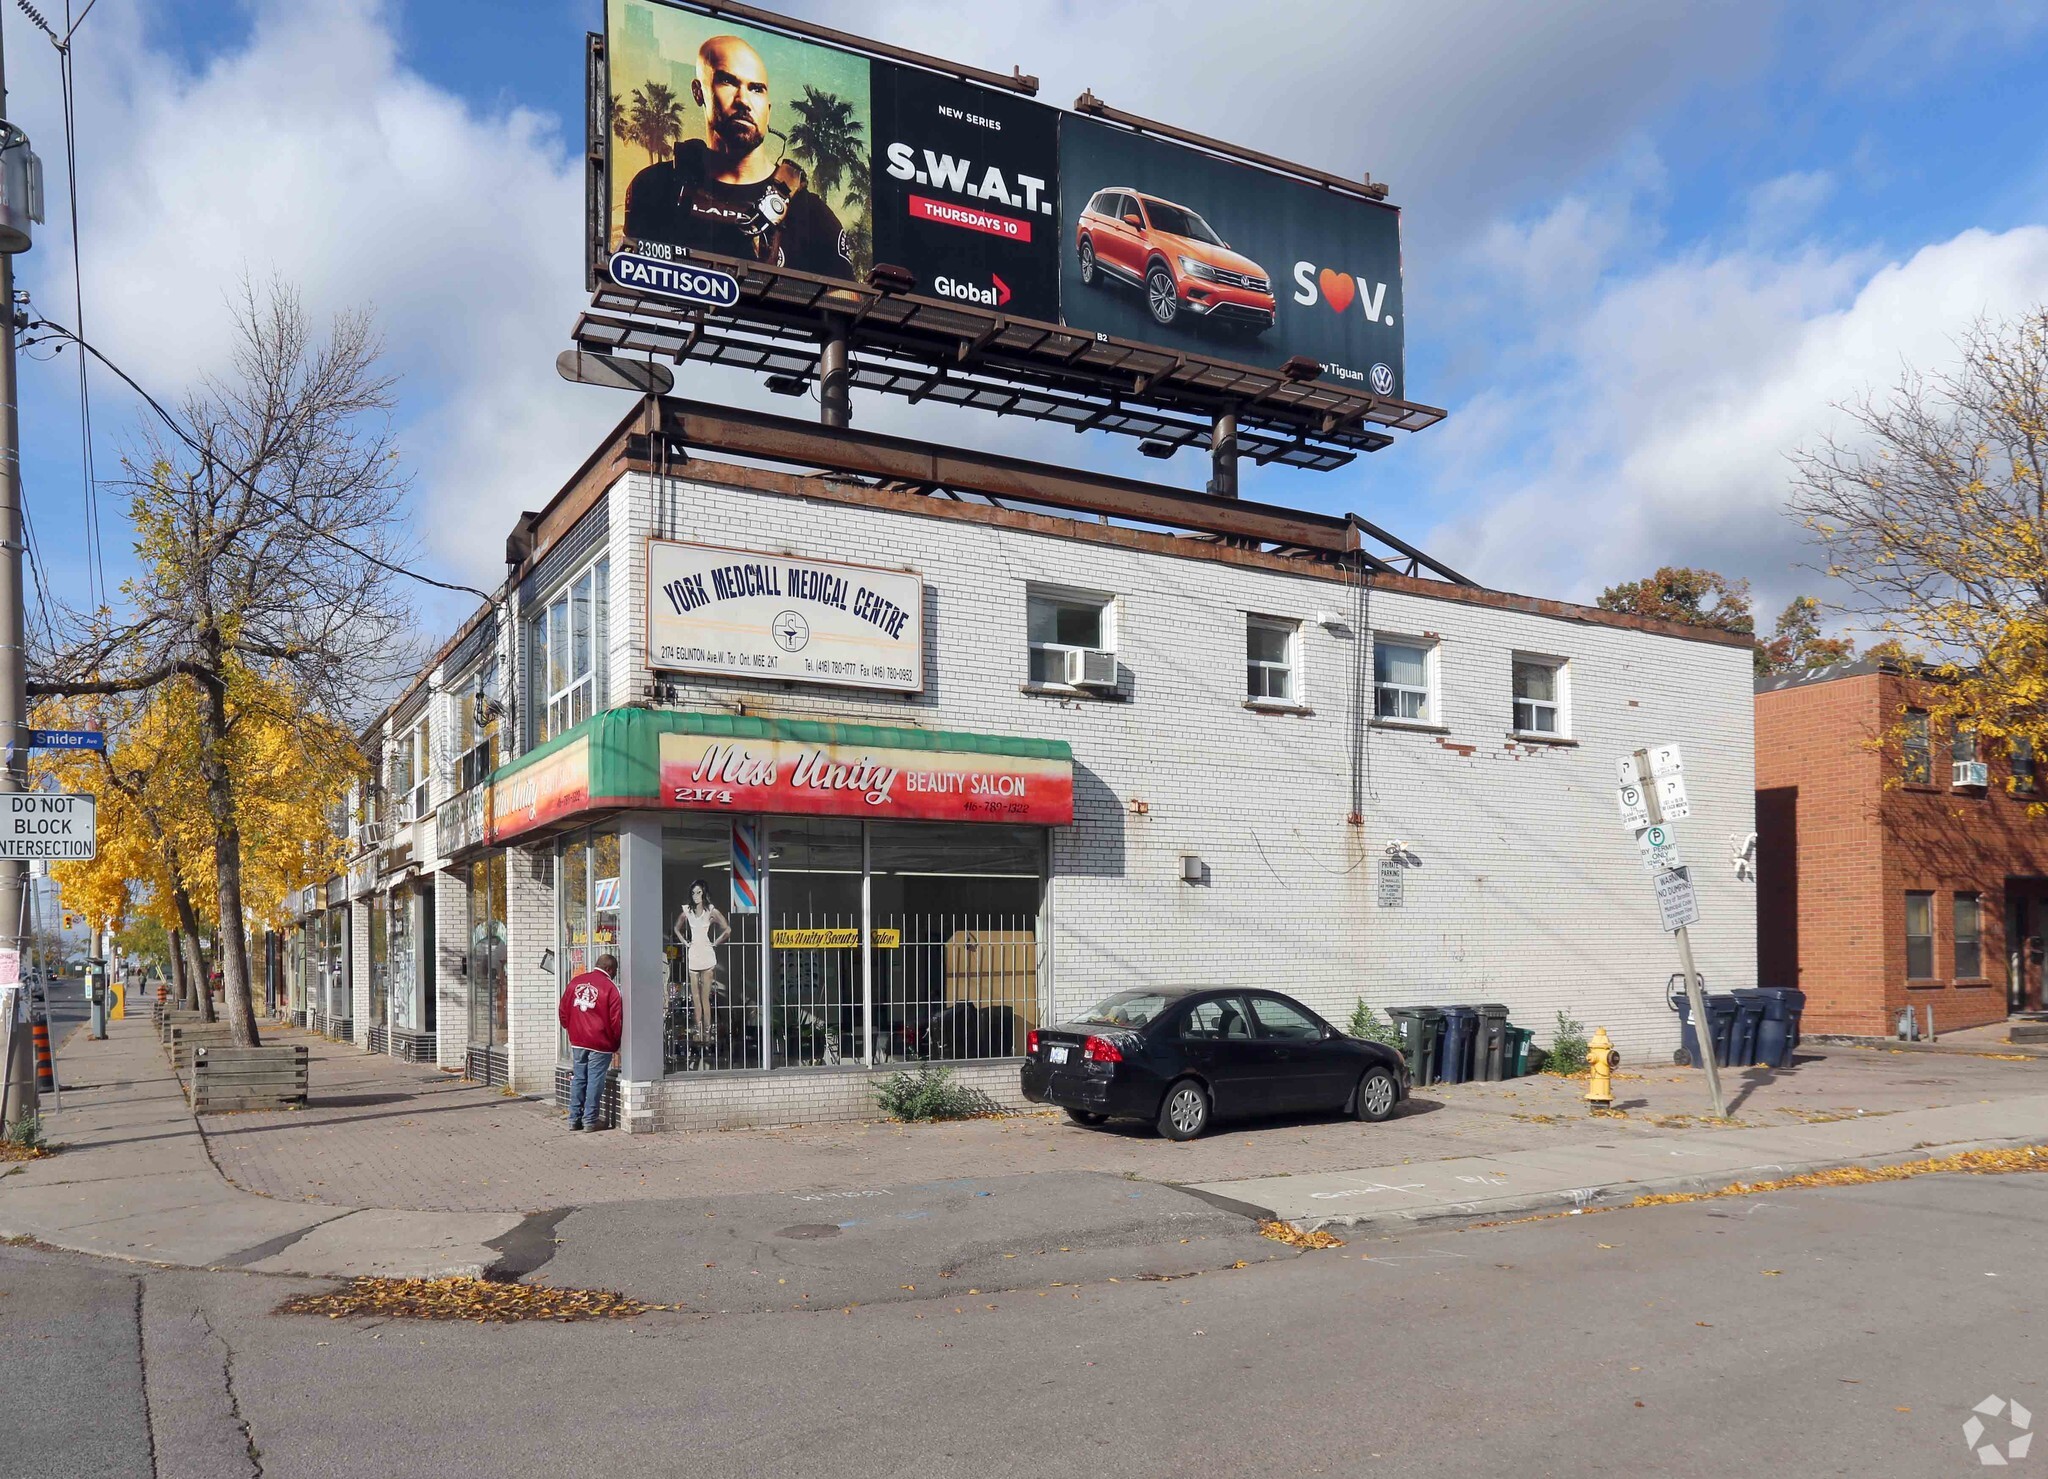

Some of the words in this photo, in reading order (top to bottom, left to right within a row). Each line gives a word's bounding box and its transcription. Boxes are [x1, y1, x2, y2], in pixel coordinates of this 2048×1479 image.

[938, 104, 963, 120] NEW
[966, 113, 1001, 131] SERIES
[886, 142, 1052, 215] S.W.A.T.
[924, 202, 1001, 231] THURSDAYS
[1003, 221, 1018, 235] 10
[638, 240, 672, 260] 2300B
[675, 245, 687, 257] B1
[620, 259, 729, 301] PATTISON
[934, 275, 998, 306] Global
[1096, 332, 1108, 342] B2
[1329, 362, 1364, 381] Tiguan
[662, 572, 711, 615] YORK
[710, 564, 781, 601] MEDCALL
[788, 568, 849, 611] MEDICAL
[853, 586, 909, 640] CENTRE
[661, 645, 674, 659] 2174
[676, 647, 705, 662] EGLINTON
[727, 651, 736, 665] Tor
[739, 653, 751, 666] Ont.
[753, 654, 765, 667] M6E
[805, 658, 814, 672] Tel.
[815, 658, 830, 674] (416)
[860, 664, 870, 677] Fax
[871, 664, 885, 680] (416)
[36, 732, 84, 745] Snider
[691, 743, 778, 786] Miss
[790, 749, 899, 805] Unity
[906, 771, 965, 793] BEAUTY
[970, 773, 1025, 797] SALON
[674, 787, 733, 804] 2174
[12, 797, 36, 813] DO
[41, 798, 75, 813] NOT
[14, 819, 72, 835] BLOCK
[0, 840, 92, 856] NTERSECTION
[1641, 848, 1650, 856] BY
[1653, 843, 1676, 853] PERMIT
[1652, 851, 1669, 860] ONLY
[1658, 888, 1668, 898] NO
[1667, 882, 1692, 896] DUMPING
[774, 931, 795, 945] Miss
[794, 931, 825, 947] Unity
[823, 930, 859, 947] Beauty
[870, 930, 895, 945] Salon
